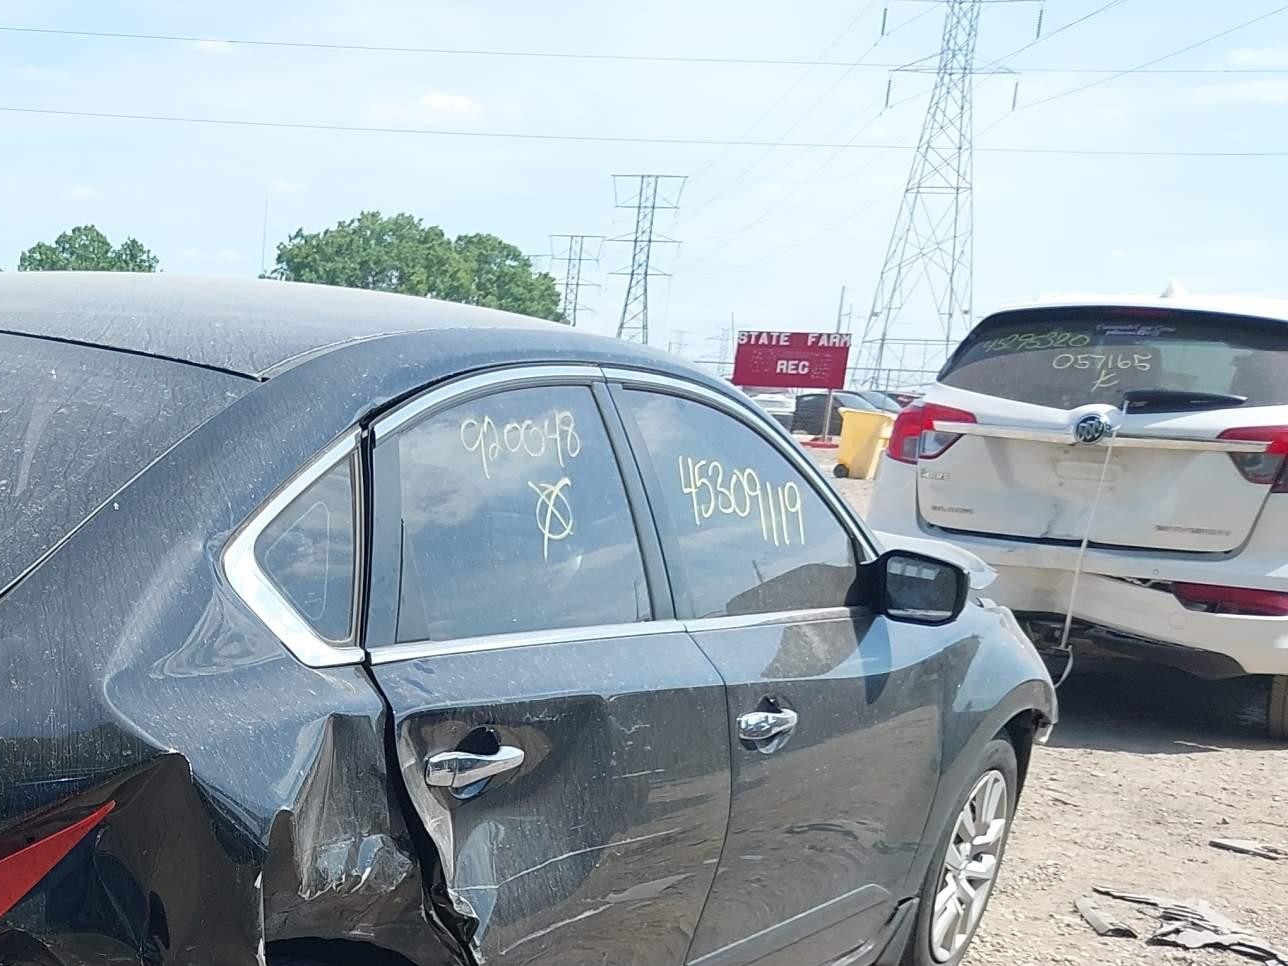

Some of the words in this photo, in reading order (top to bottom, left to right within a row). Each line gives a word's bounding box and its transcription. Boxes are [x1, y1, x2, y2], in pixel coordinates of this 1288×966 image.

[737, 331, 791, 346] STATE
[807, 333, 852, 347] FARM
[776, 360, 810, 375] REG
[1051, 353, 1152, 372] 057165
[460, 408, 581, 479] 920048
[678, 455, 805, 546] 45309119
